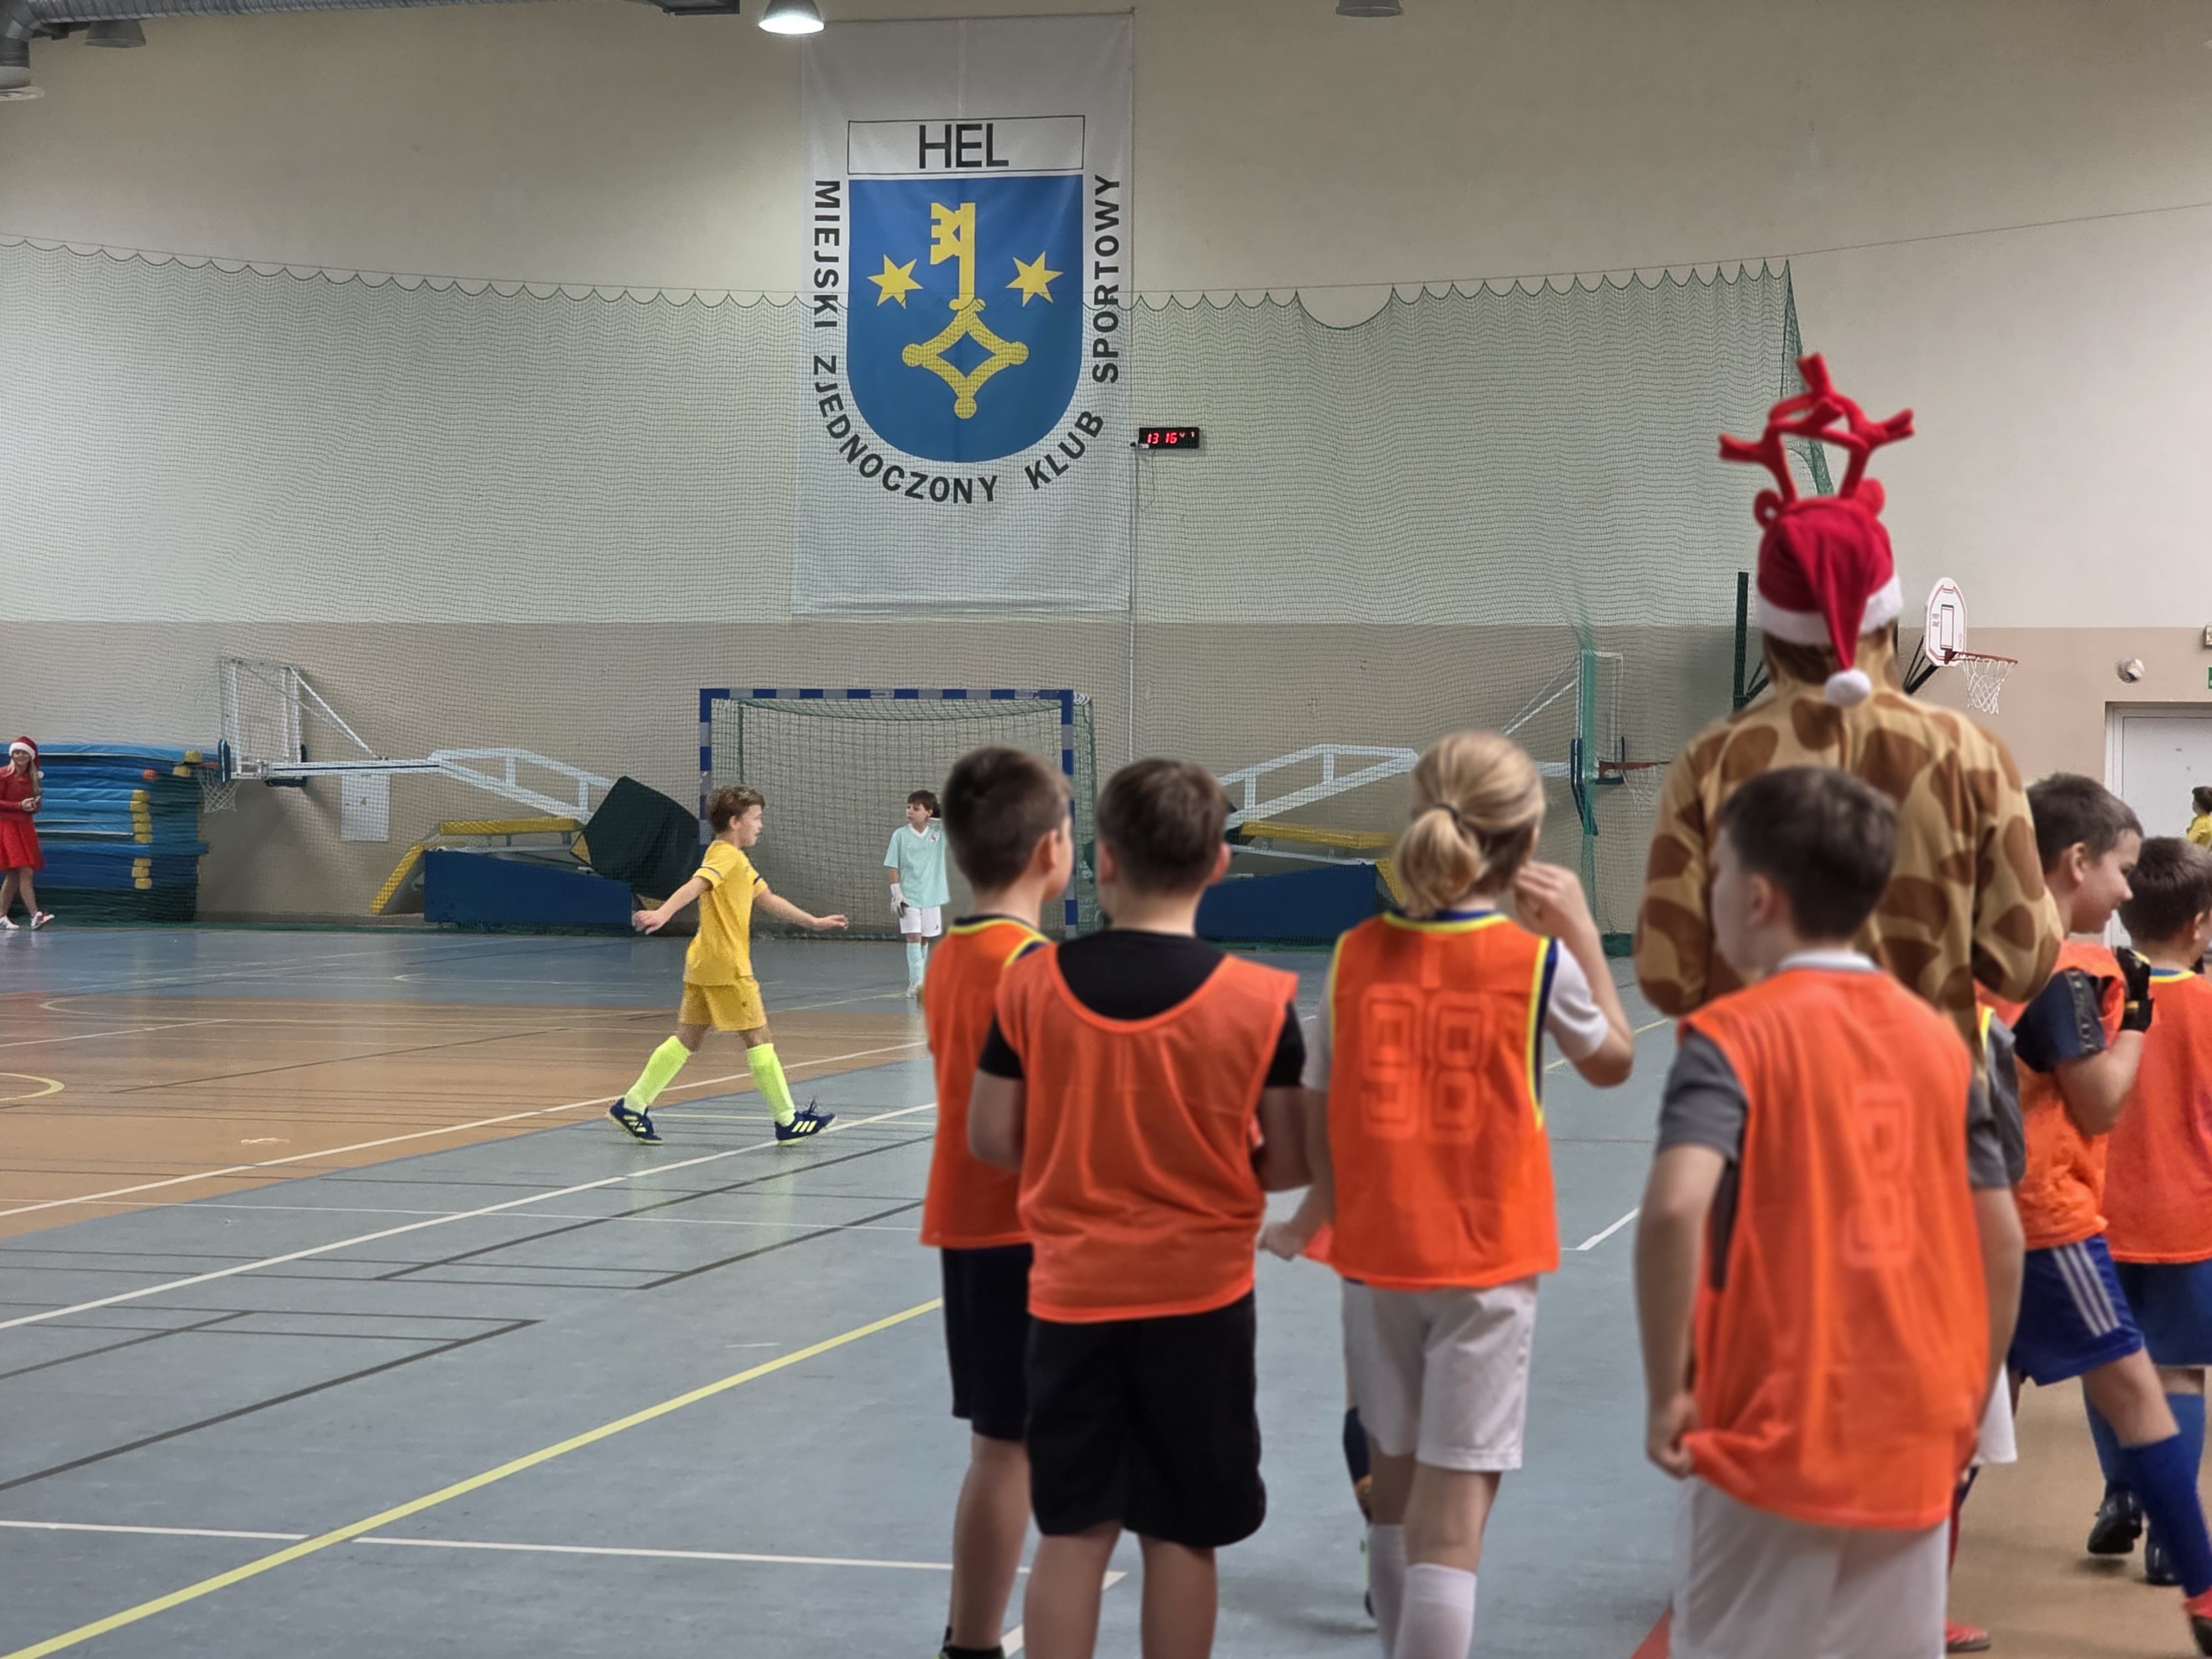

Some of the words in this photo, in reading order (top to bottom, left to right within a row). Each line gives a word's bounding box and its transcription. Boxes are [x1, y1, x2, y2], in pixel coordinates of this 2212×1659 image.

[919, 123, 1009, 169] HEL
[813, 180, 840, 328] MIEJSKI
[1092, 174, 1120, 384] SPORTOWY
[813, 354, 998, 504] ZJEDNOCZONY
[1024, 410, 1104, 490] KLUB
